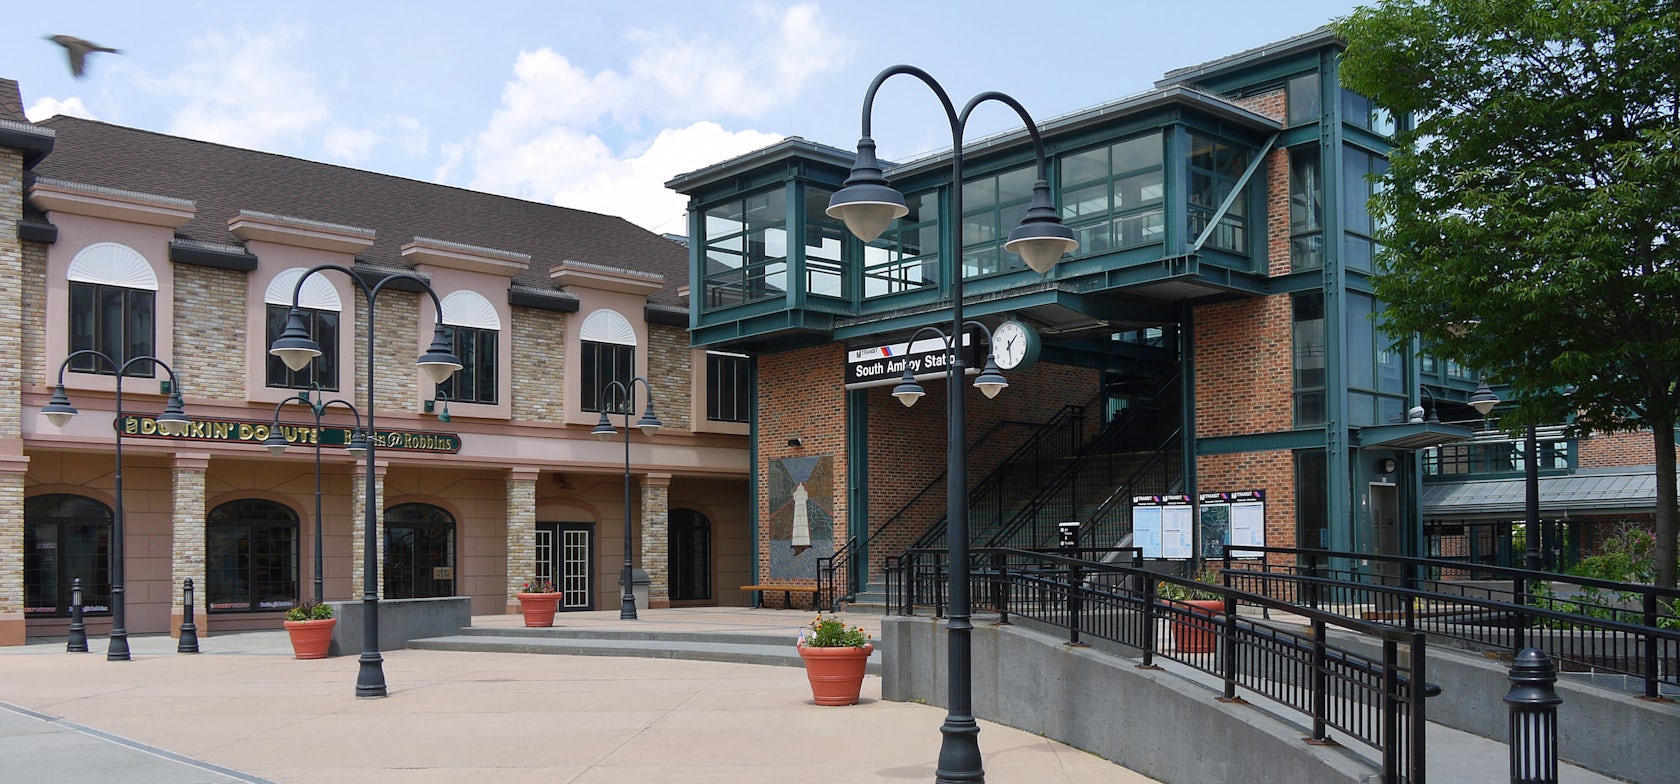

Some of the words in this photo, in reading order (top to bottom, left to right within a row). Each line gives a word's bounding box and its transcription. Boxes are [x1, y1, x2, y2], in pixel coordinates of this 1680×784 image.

[856, 363, 884, 377] South
[924, 354, 956, 368] Stato
[404, 433, 452, 450] Robbins
